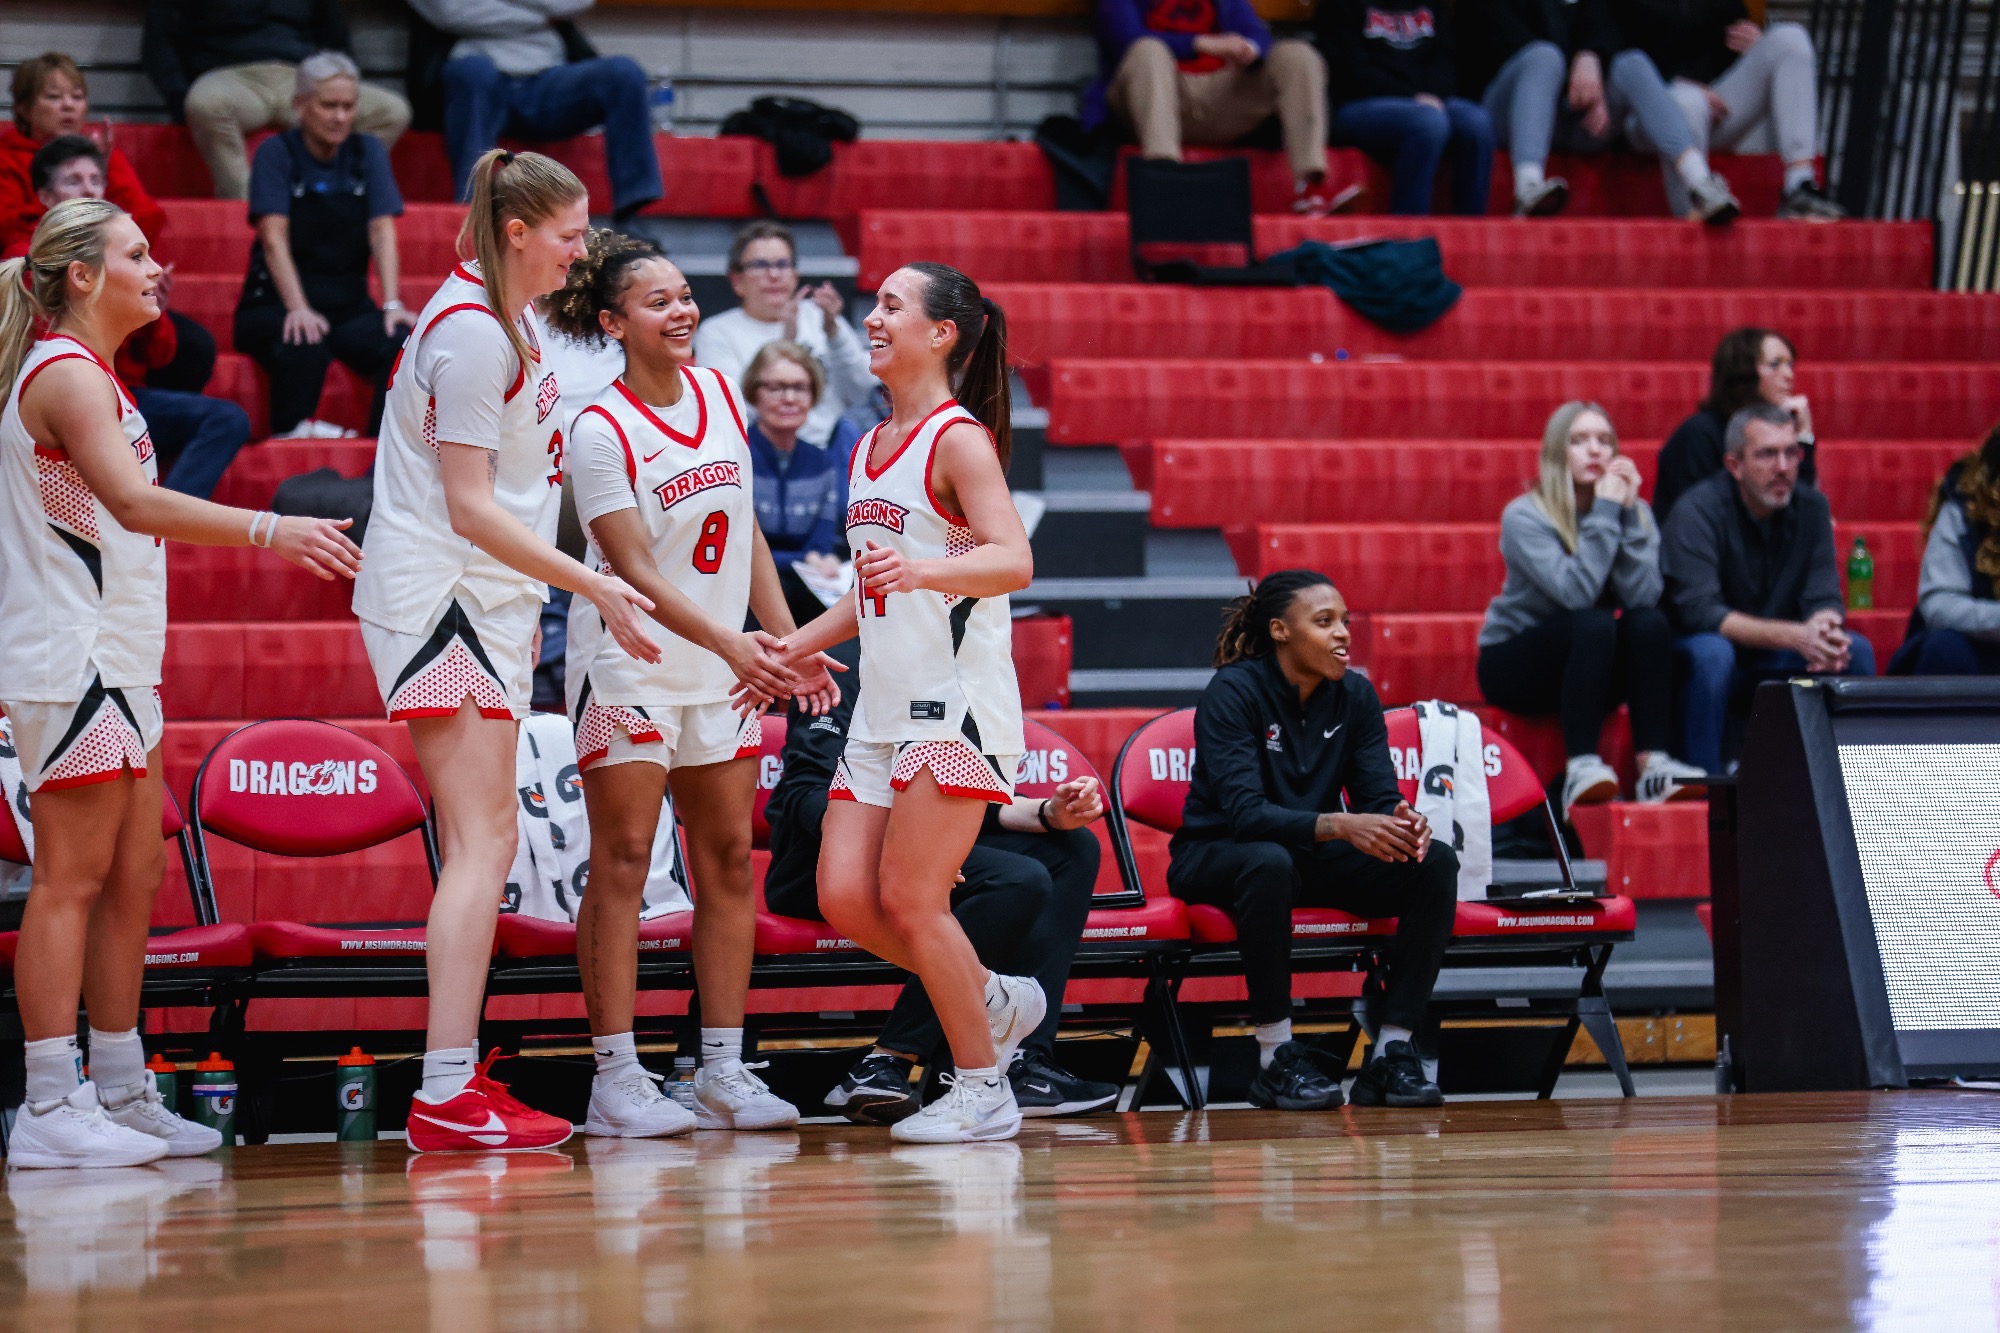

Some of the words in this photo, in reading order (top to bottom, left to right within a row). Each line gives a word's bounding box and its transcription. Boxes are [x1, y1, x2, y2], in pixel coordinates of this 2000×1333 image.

[655, 461, 741, 510] DRAGONS
[846, 499, 905, 533] RAGONS
[692, 510, 729, 574] 8
[229, 758, 378, 796] DRAGONS
[341, 940, 427, 951] WWW.MSUMDRAGONS
